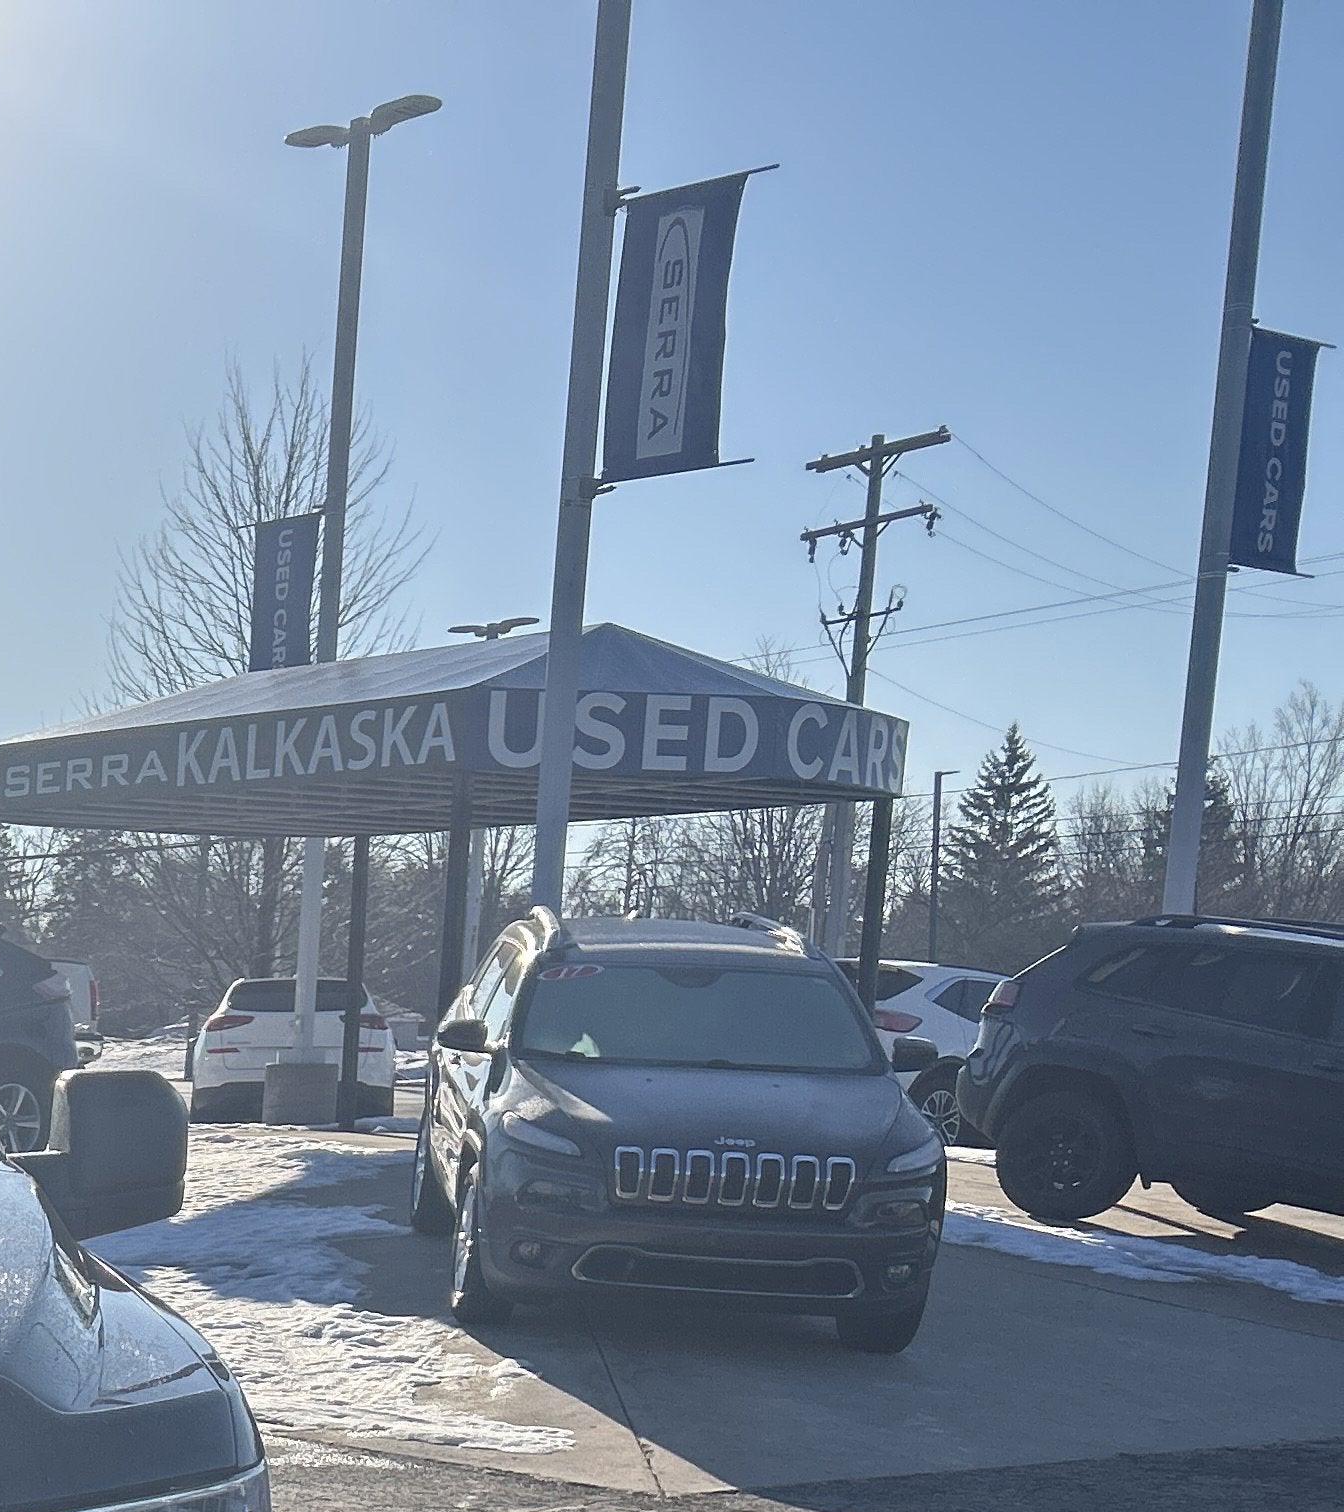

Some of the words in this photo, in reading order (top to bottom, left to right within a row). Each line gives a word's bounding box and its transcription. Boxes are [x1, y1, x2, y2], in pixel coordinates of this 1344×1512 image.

[647, 258, 684, 441] SERRA
[1269, 350, 1293, 447] USED
[1257, 457, 1283, 553] CARS
[274, 529, 294, 601] USED
[271, 608, 288, 670] CAR
[4, 750, 168, 798] SERRA
[176, 702, 456, 788] KALKASKA
[487, 690, 760, 773] USED
[787, 703, 909, 795] CARS
[714, 1136, 756, 1148] Jeep
